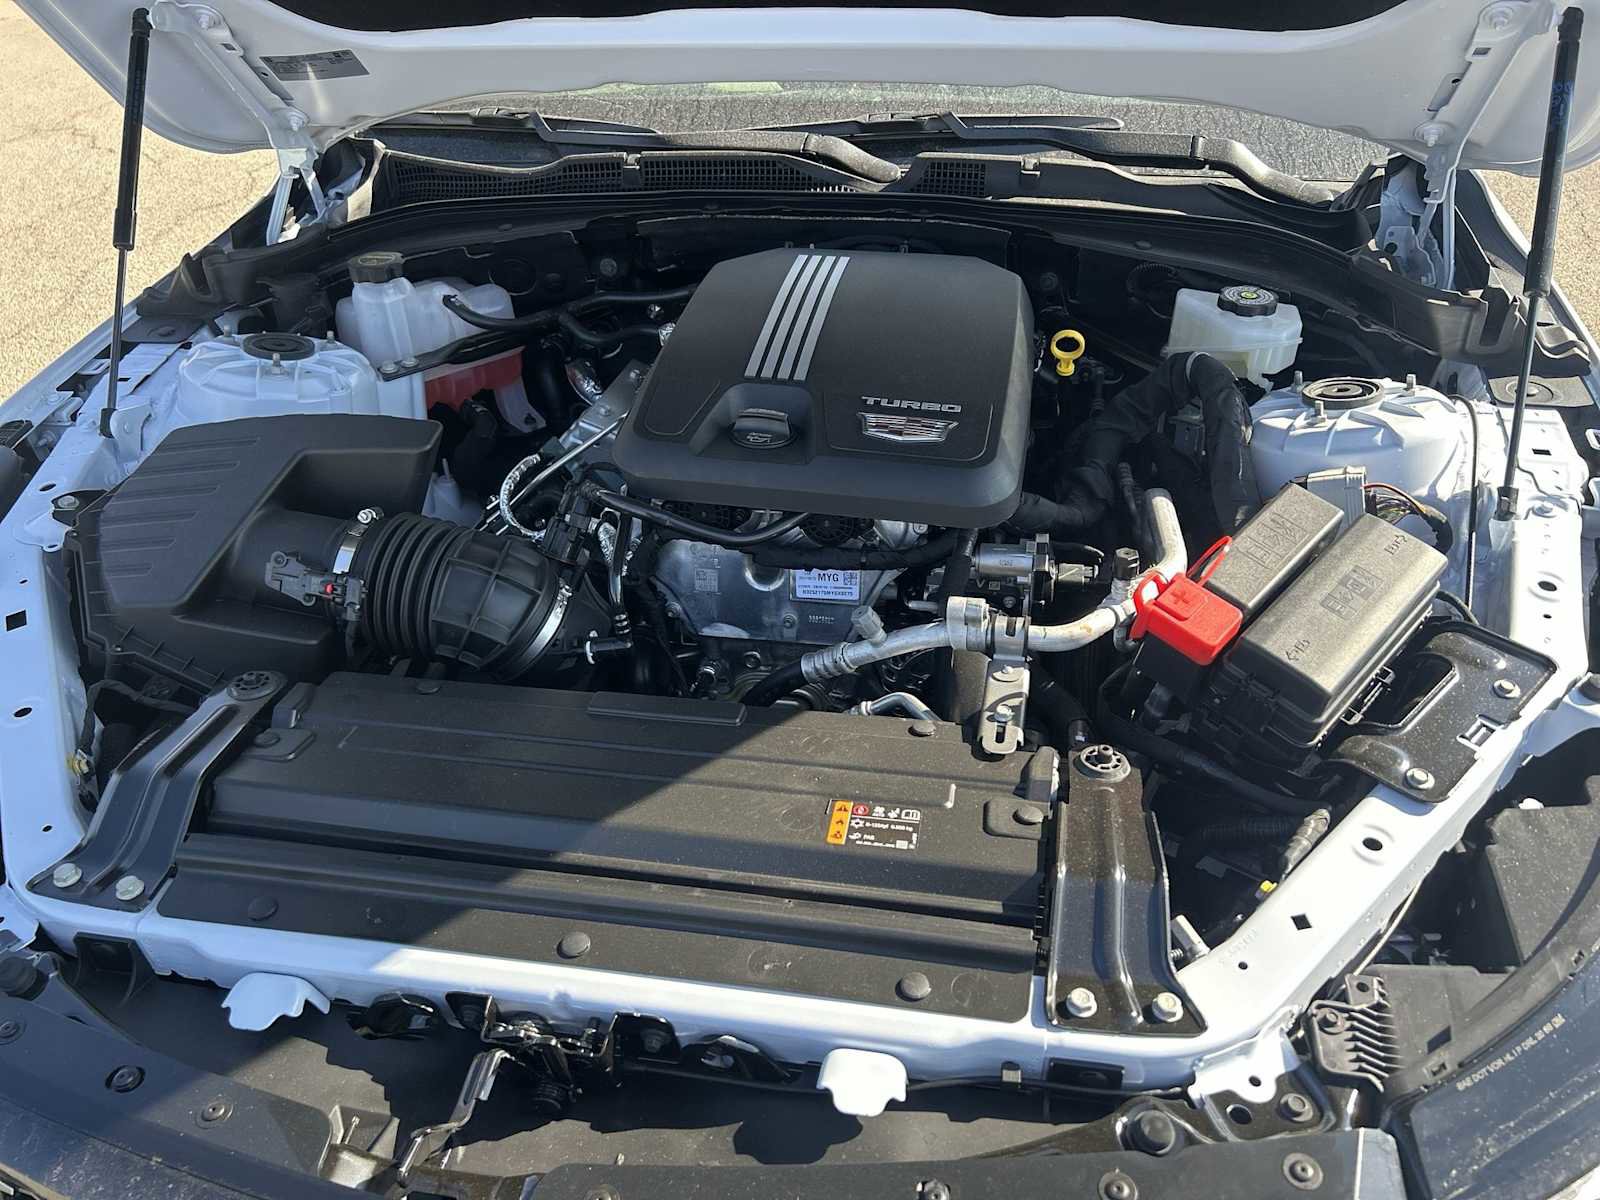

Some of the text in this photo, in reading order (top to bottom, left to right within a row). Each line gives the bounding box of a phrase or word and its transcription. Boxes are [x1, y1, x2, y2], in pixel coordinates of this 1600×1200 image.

[861, 396, 962, 413] TURBO
[817, 573, 839, 582] MYG
[1472, 1067, 1489, 1082] DOT
